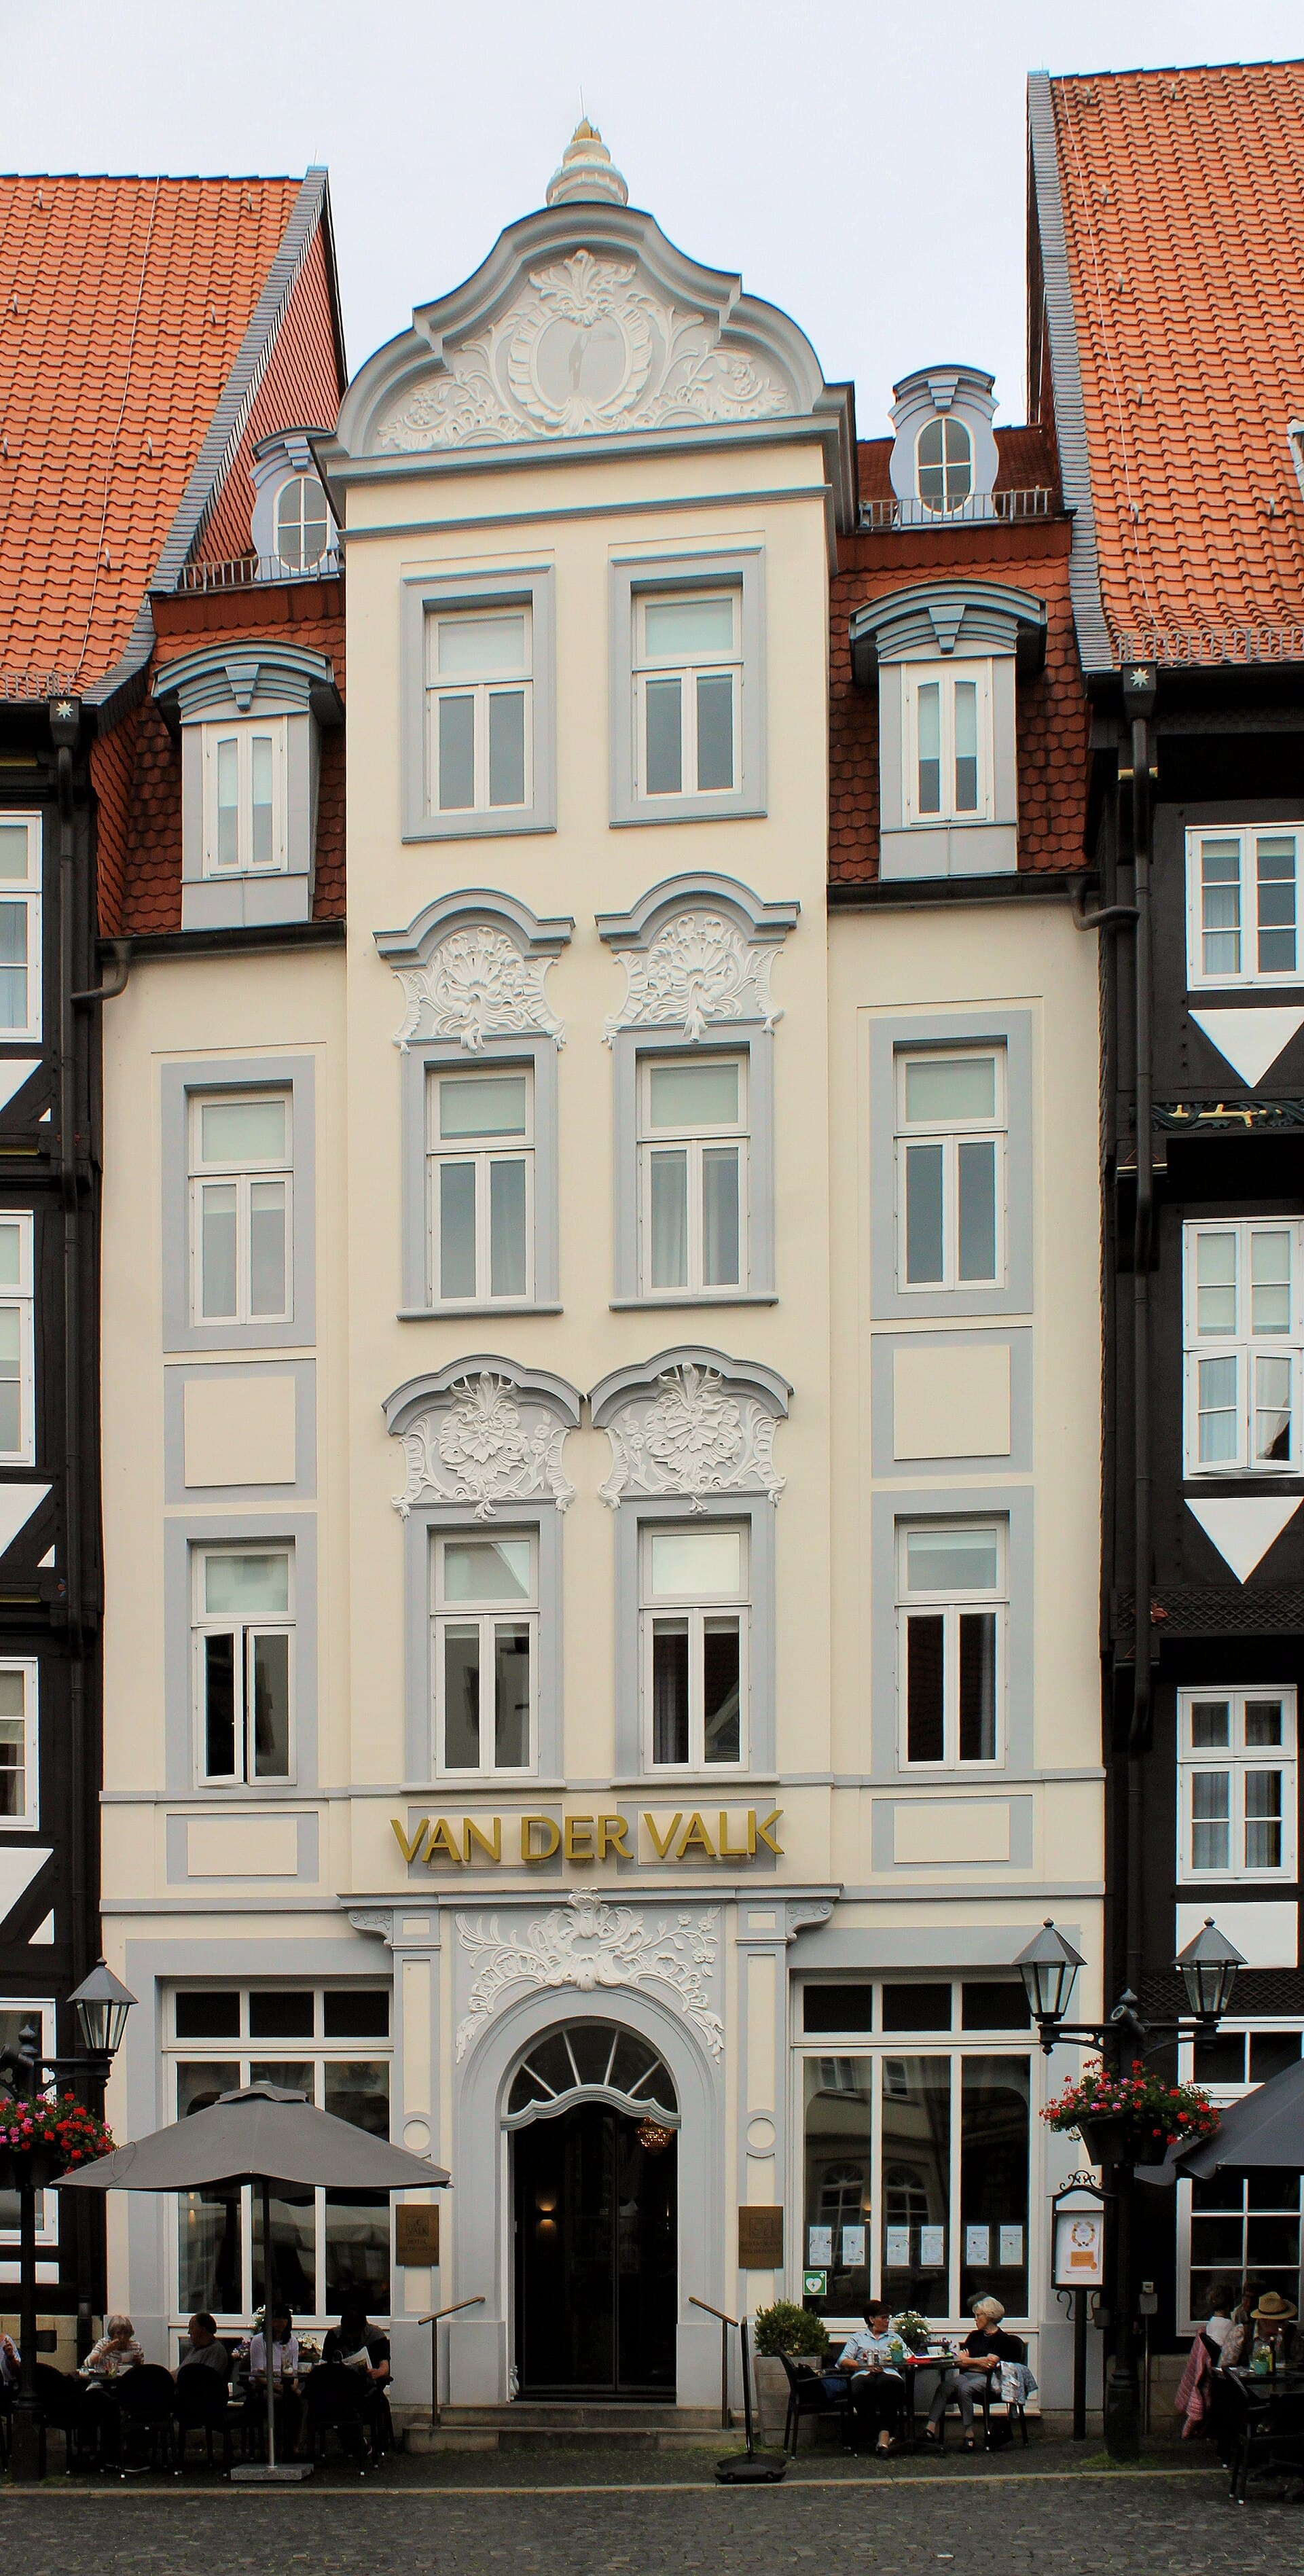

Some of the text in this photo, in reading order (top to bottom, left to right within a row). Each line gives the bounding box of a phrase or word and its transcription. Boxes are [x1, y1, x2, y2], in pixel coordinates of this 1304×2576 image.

[391, 1810, 784, 1863] VAN DER VALK
